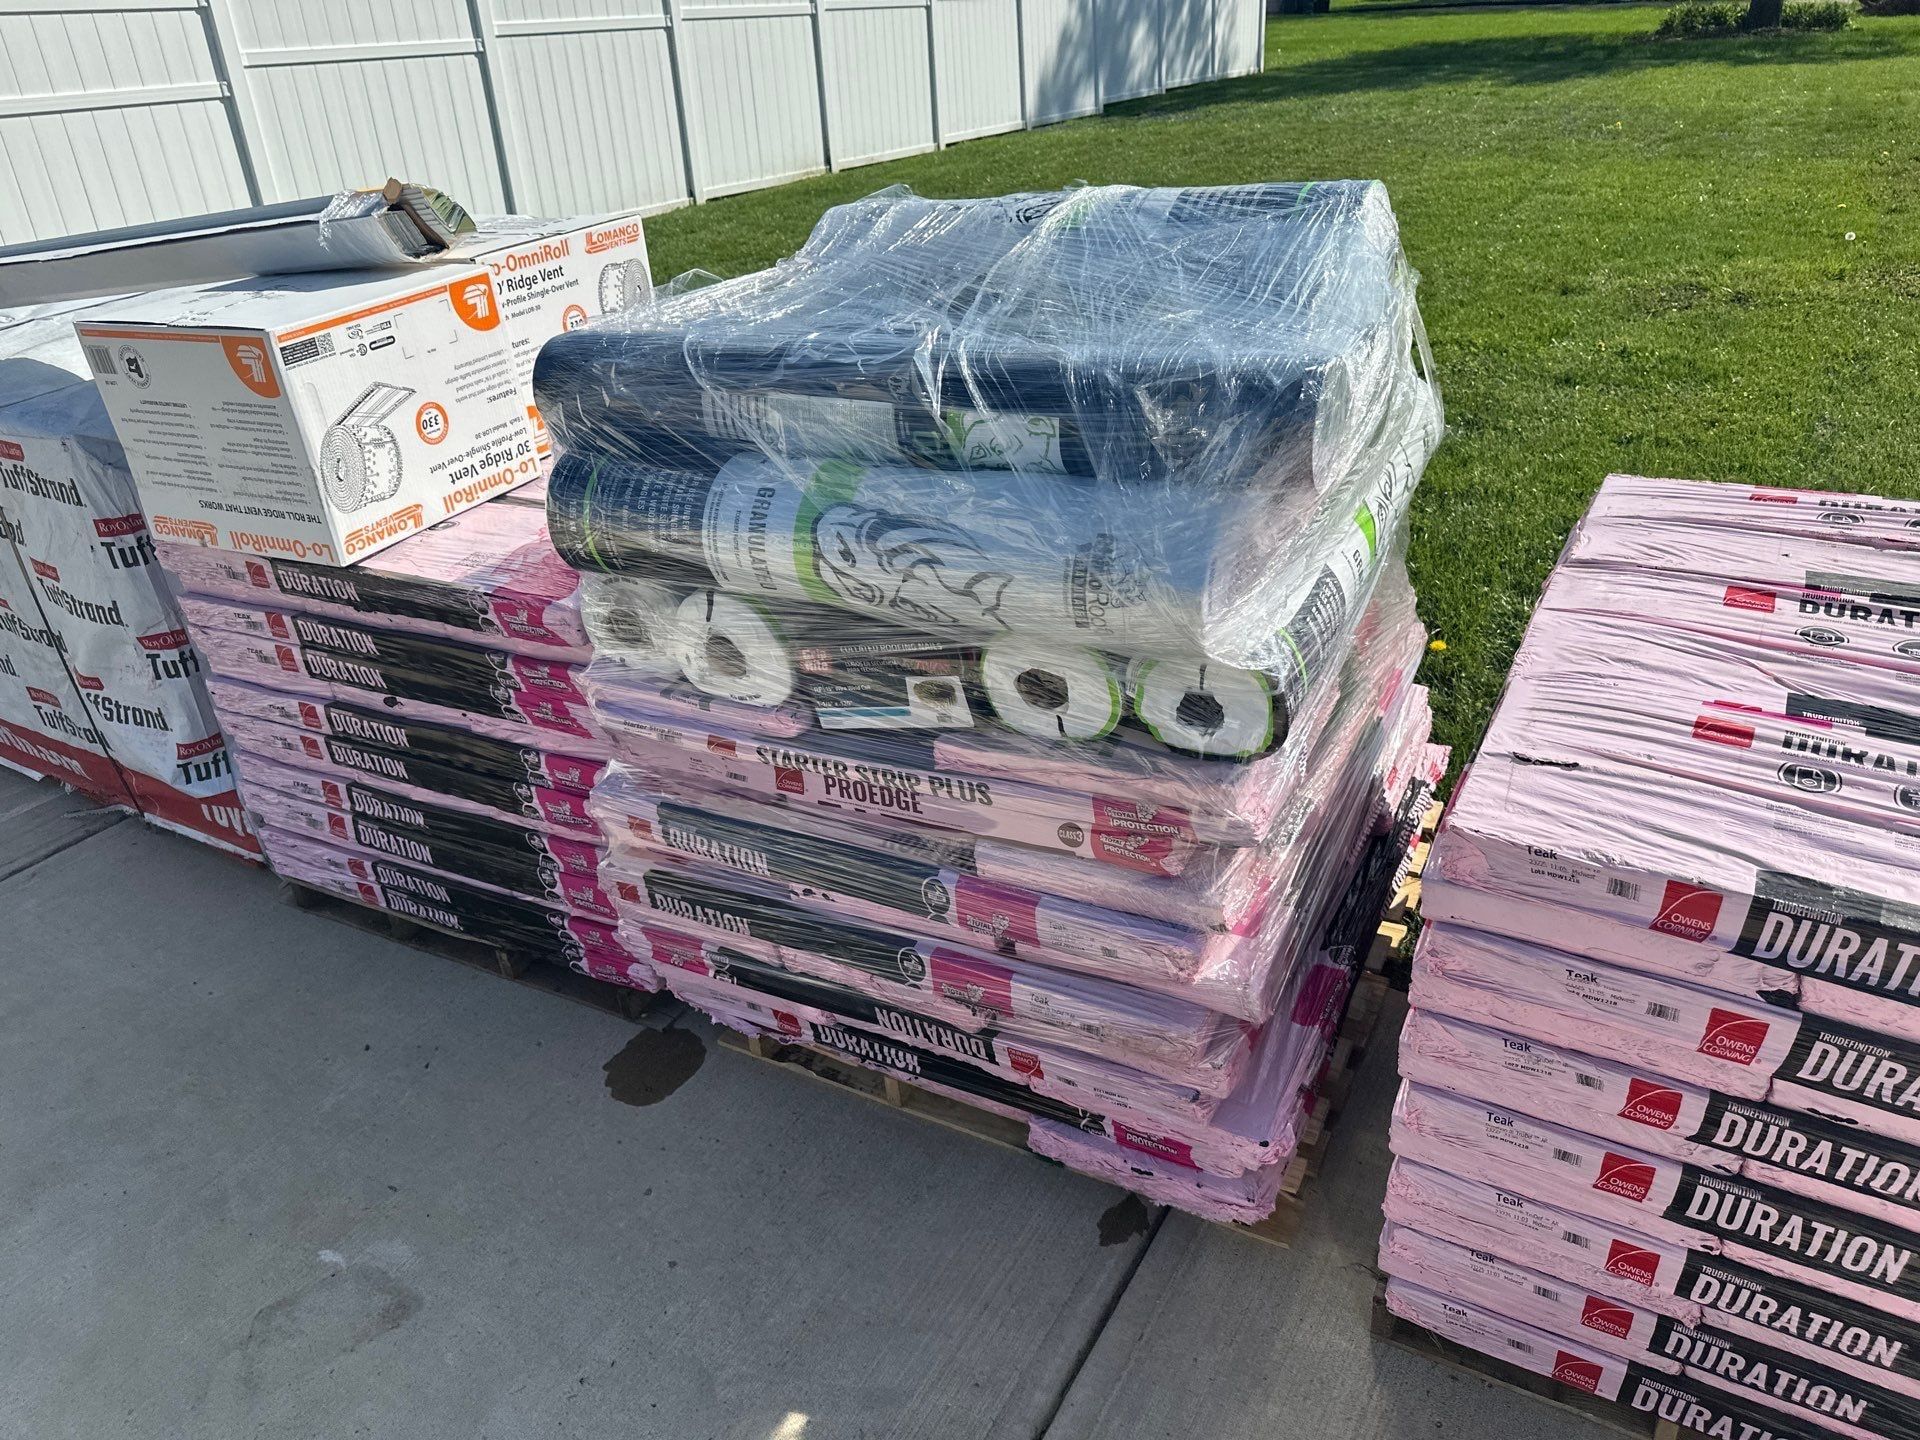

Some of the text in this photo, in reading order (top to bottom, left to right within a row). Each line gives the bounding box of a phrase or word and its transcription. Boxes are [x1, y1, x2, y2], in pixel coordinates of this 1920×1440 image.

[586, 223, 639, 253] LOMANCO
[606, 239, 627, 250] VENTS
[493, 239, 570, 276] o-OmniRoll
[507, 265, 564, 293] Ridge Vent
[526, 279, 579, 303] Shingle-Over Vent
[511, 337, 530, 349] tures:
[486, 386, 518, 405] Features:
[421, 413, 441, 431] 330
[430, 427, 528, 475] Low-Profile Shingle-Over Vent
[479, 447, 514, 473] Ridge
[442, 456, 538, 515] Lo-OmniRoll
[449, 464, 478, 485] Vent
[169, 517, 195, 528] VENTS
[198, 499, 322, 524] THE ROLL RIDGE VENT THAT WORKS
[155, 522, 219, 547] LOMANCO
[345, 508, 424, 556] LOMANCO
[364, 514, 395, 536] VENTS
[230, 530, 335, 563] Lo-OmniRoll
[277, 569, 361, 602] DURATION
[296, 619, 380, 656] DURATION
[306, 653, 388, 690] DURATION
[330, 711, 411, 748] DURATION
[1802, 711, 1862, 728] TRUDEFINITION
[1784, 730, 1848, 747] TRUDEFINITION
[331, 744, 410, 780] DURATION
[756, 744, 994, 806] STARTER STRIP PLUS
[823, 774, 924, 815] PROEDGE
[352, 791, 426, 827] DURATION
[1113, 819, 1180, 834] PROTECTION
[357, 824, 434, 865] DURATION
[669, 827, 771, 876] DURATION
[1104, 844, 1151, 862] PROTECTION
[1526, 845, 1558, 860] Teak
[377, 866, 452, 904] DURATION
[656, 892, 752, 937] DURATION
[970, 918, 993, 931] TOTAL
[1671, 912, 1712, 932] OWENS
[1772, 899, 1844, 926] TRUDEFINITION
[1656, 919, 1707, 940] CORNING
[1565, 968, 1598, 984] Teak
[874, 1005, 988, 1060] DURATION
[1502, 1037, 1532, 1053] Teak
[1715, 1035, 1757, 1054] OWENS
[1818, 1031, 1892, 1059] TRUDEFINITION
[818, 1024, 922, 1075] DURATION
[1702, 1042, 1751, 1064] CORNING
[1486, 1111, 1514, 1128] Teak
[1624, 1108, 1671, 1128] CORNING
[1636, 1103, 1674, 1122] OWENS
[1726, 1101, 1791, 1128] TRUDEFINITION
[1126, 1132, 1179, 1156] PROTECTION
[1597, 1181, 1644, 1201] CORNING
[1609, 1177, 1646, 1194] OWENS
[1698, 1173, 1762, 1201] TRUDEFINITION
[1495, 1192, 1524, 1209] Teak
[1684, 1184, 1913, 1285] DURATION
[1469, 1249, 1496, 1265] Teak
[1608, 1266, 1651, 1286] CORNING
[1617, 1261, 1653, 1280] OWENS
[1701, 1265, 1763, 1293] TRUDEFINITION
[1441, 1302, 1469, 1318] Teak
[1689, 1272, 1903, 1369] DURATION
[1592, 1316, 1627, 1335] OWENS
[1672, 1321, 1732, 1350] TRUDEFINITION
[1563, 1367, 1597, 1386] OWENS
[1663, 1331, 1868, 1424] DURATION
[1641, 1377, 1697, 1404] TRUDEFINITION
